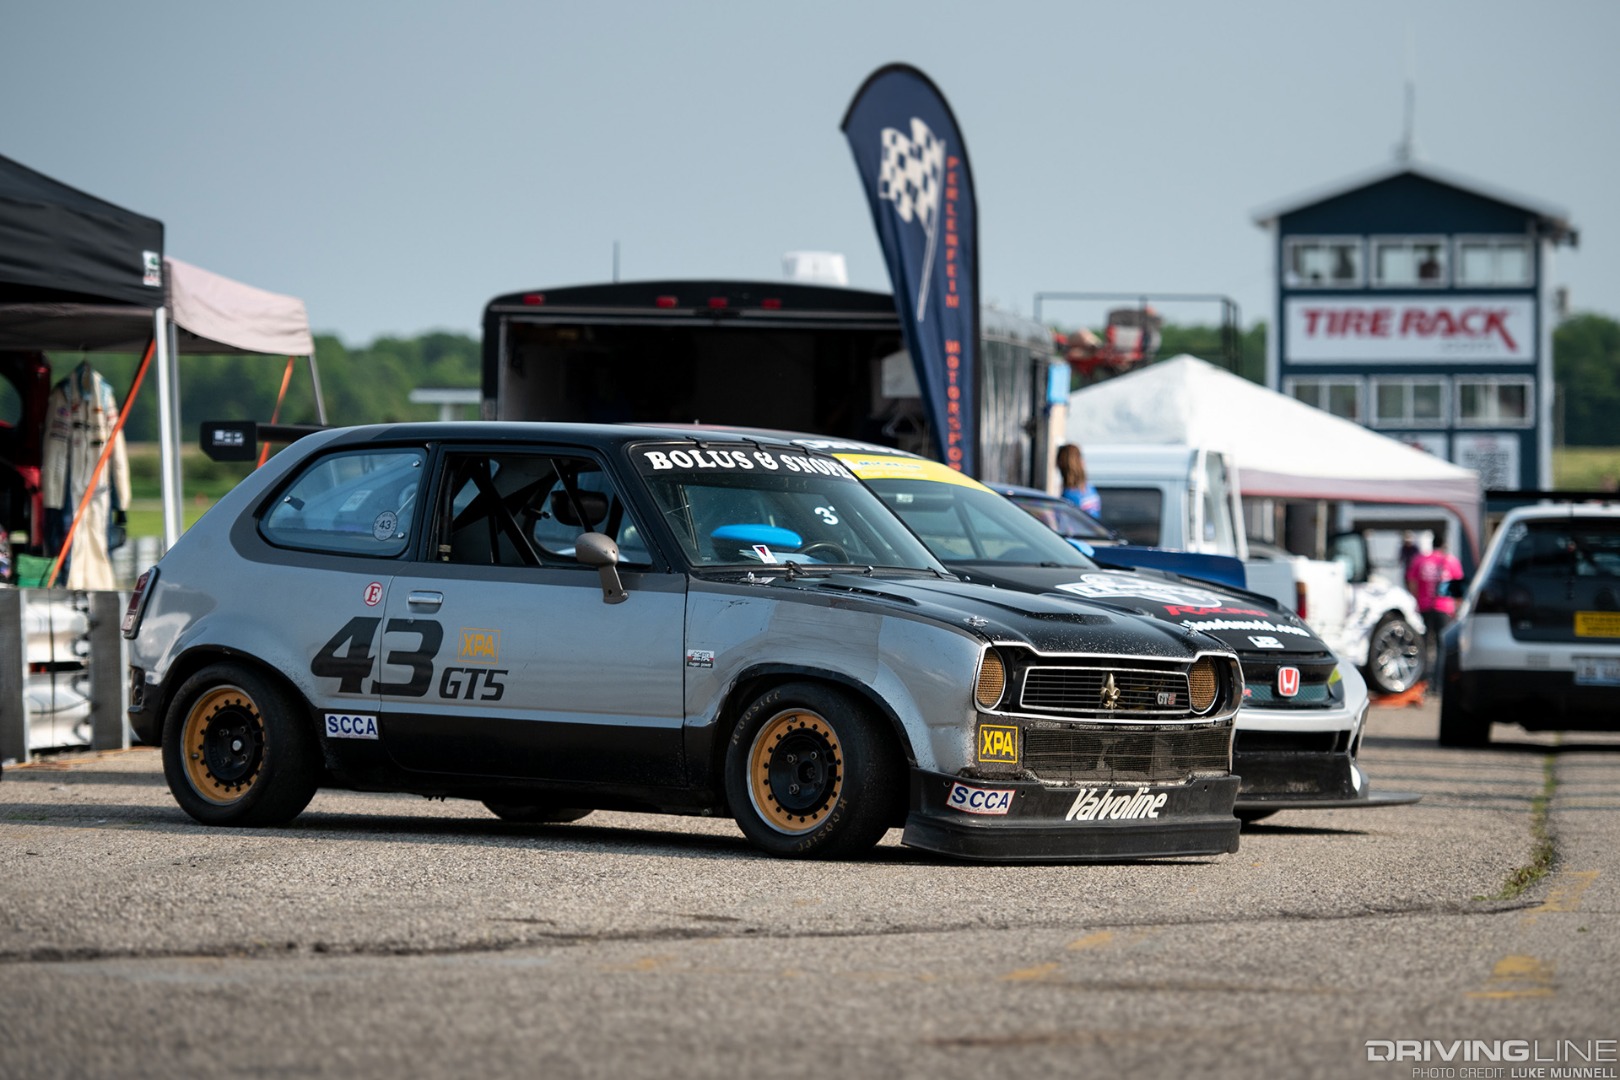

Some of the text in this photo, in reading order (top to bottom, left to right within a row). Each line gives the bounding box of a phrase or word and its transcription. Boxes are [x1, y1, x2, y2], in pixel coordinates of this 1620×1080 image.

[1303, 307, 1519, 352] TIRE RACK
[644, 450, 754, 470] BOLUS
[754, 452, 779, 470] &
[379, 520, 392, 530] 43
[367, 585, 381, 603] E
[311, 616, 444, 697] 43
[461, 633, 495, 657] XPA
[328, 715, 377, 735] SCCA
[982, 730, 1015, 757] XPA
[952, 786, 1009, 809] SCCA
[1065, 787, 1168, 821] Valvoline
